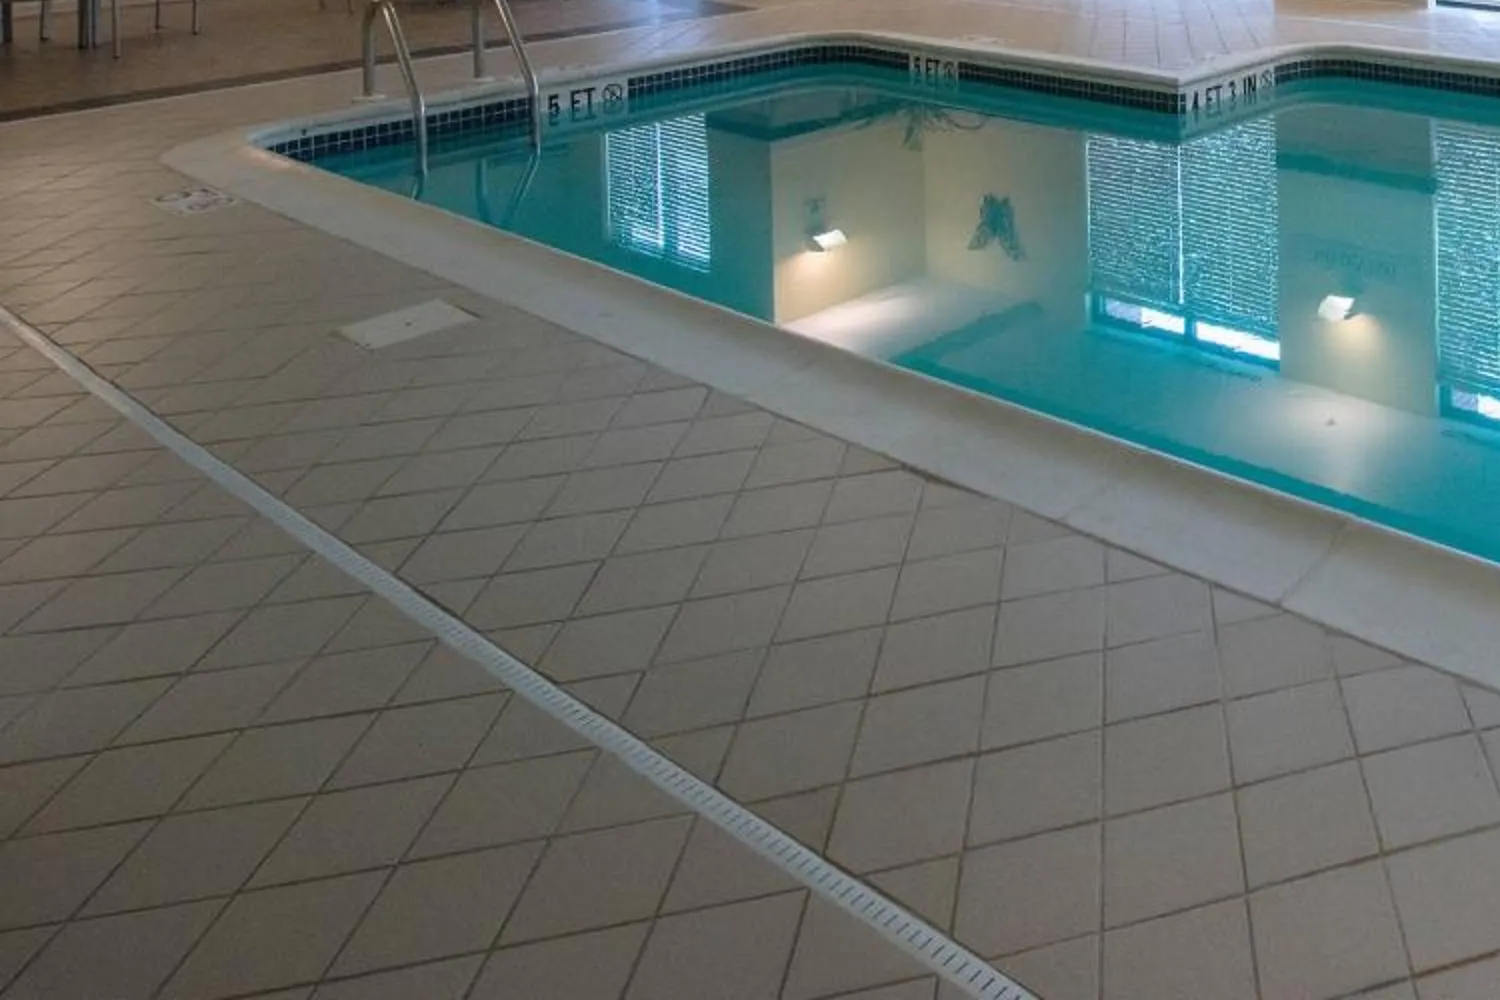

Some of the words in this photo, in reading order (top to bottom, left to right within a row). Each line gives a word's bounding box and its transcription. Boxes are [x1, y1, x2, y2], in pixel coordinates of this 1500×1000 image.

[1243, 73, 1257, 96] IN
[548, 94, 560, 113] 5
[569, 87, 596, 111] FT
